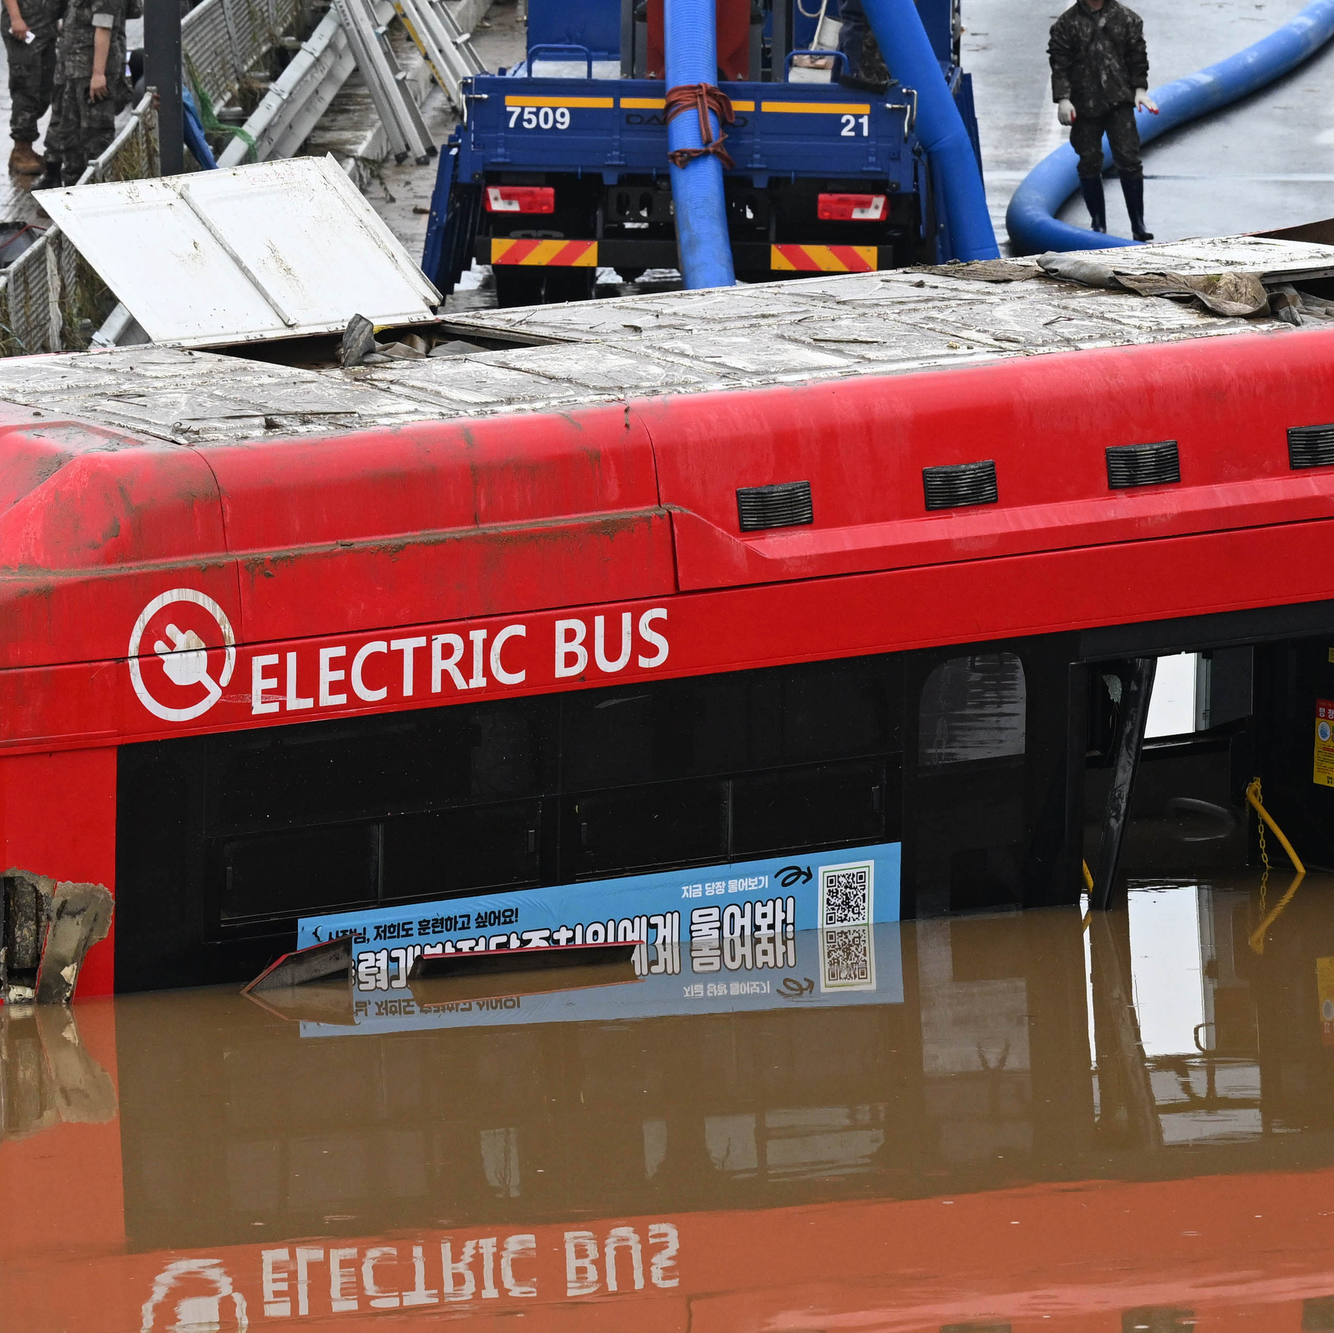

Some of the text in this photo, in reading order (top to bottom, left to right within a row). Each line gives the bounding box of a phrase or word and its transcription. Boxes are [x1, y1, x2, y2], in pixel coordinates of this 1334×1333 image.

[505, 105, 571, 131] 7509
[840, 114, 870, 138] 21
[251, 607, 670, 716] ELECTRIC BUS
[681, 875, 769, 899] 지금 당장 물어보기
[373, 920, 415, 942] 저희도
[417, 914, 471, 936] 훈련하고
[474, 907, 519, 929] 싶어요!
